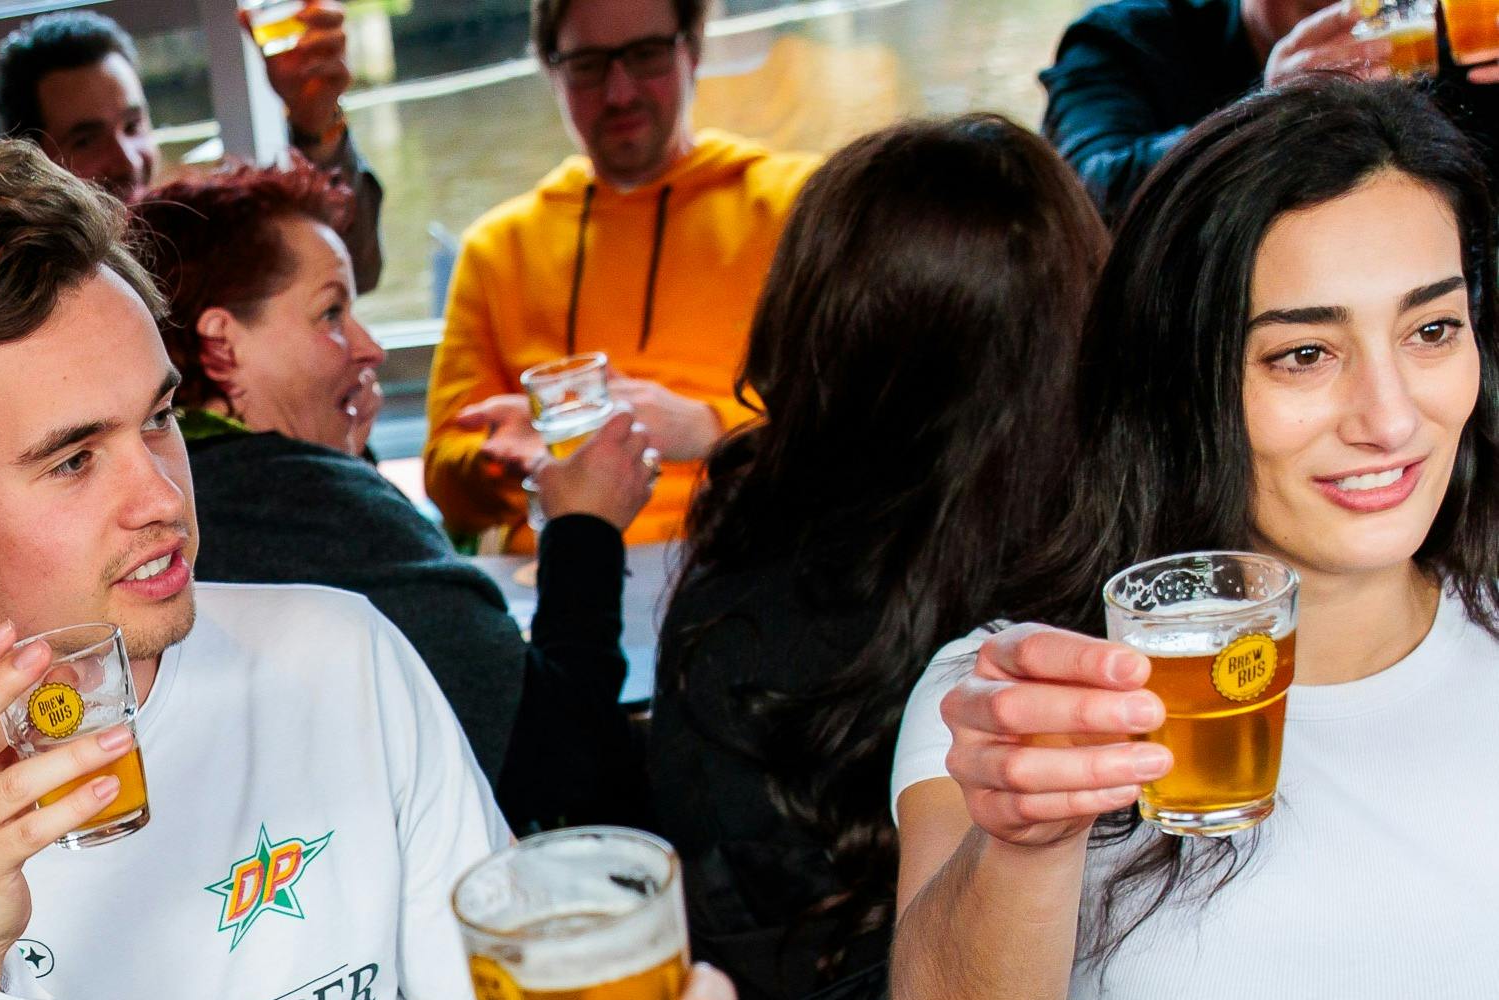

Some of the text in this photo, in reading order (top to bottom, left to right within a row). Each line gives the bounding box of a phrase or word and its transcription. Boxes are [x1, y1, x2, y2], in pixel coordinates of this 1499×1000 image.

[1228, 645, 1263, 674] BREW
[1238, 661, 1265, 688] BUS
[38, 692, 65, 717] BREW
[48, 705, 73, 728] BUS
[226, 842, 304, 922] DP
